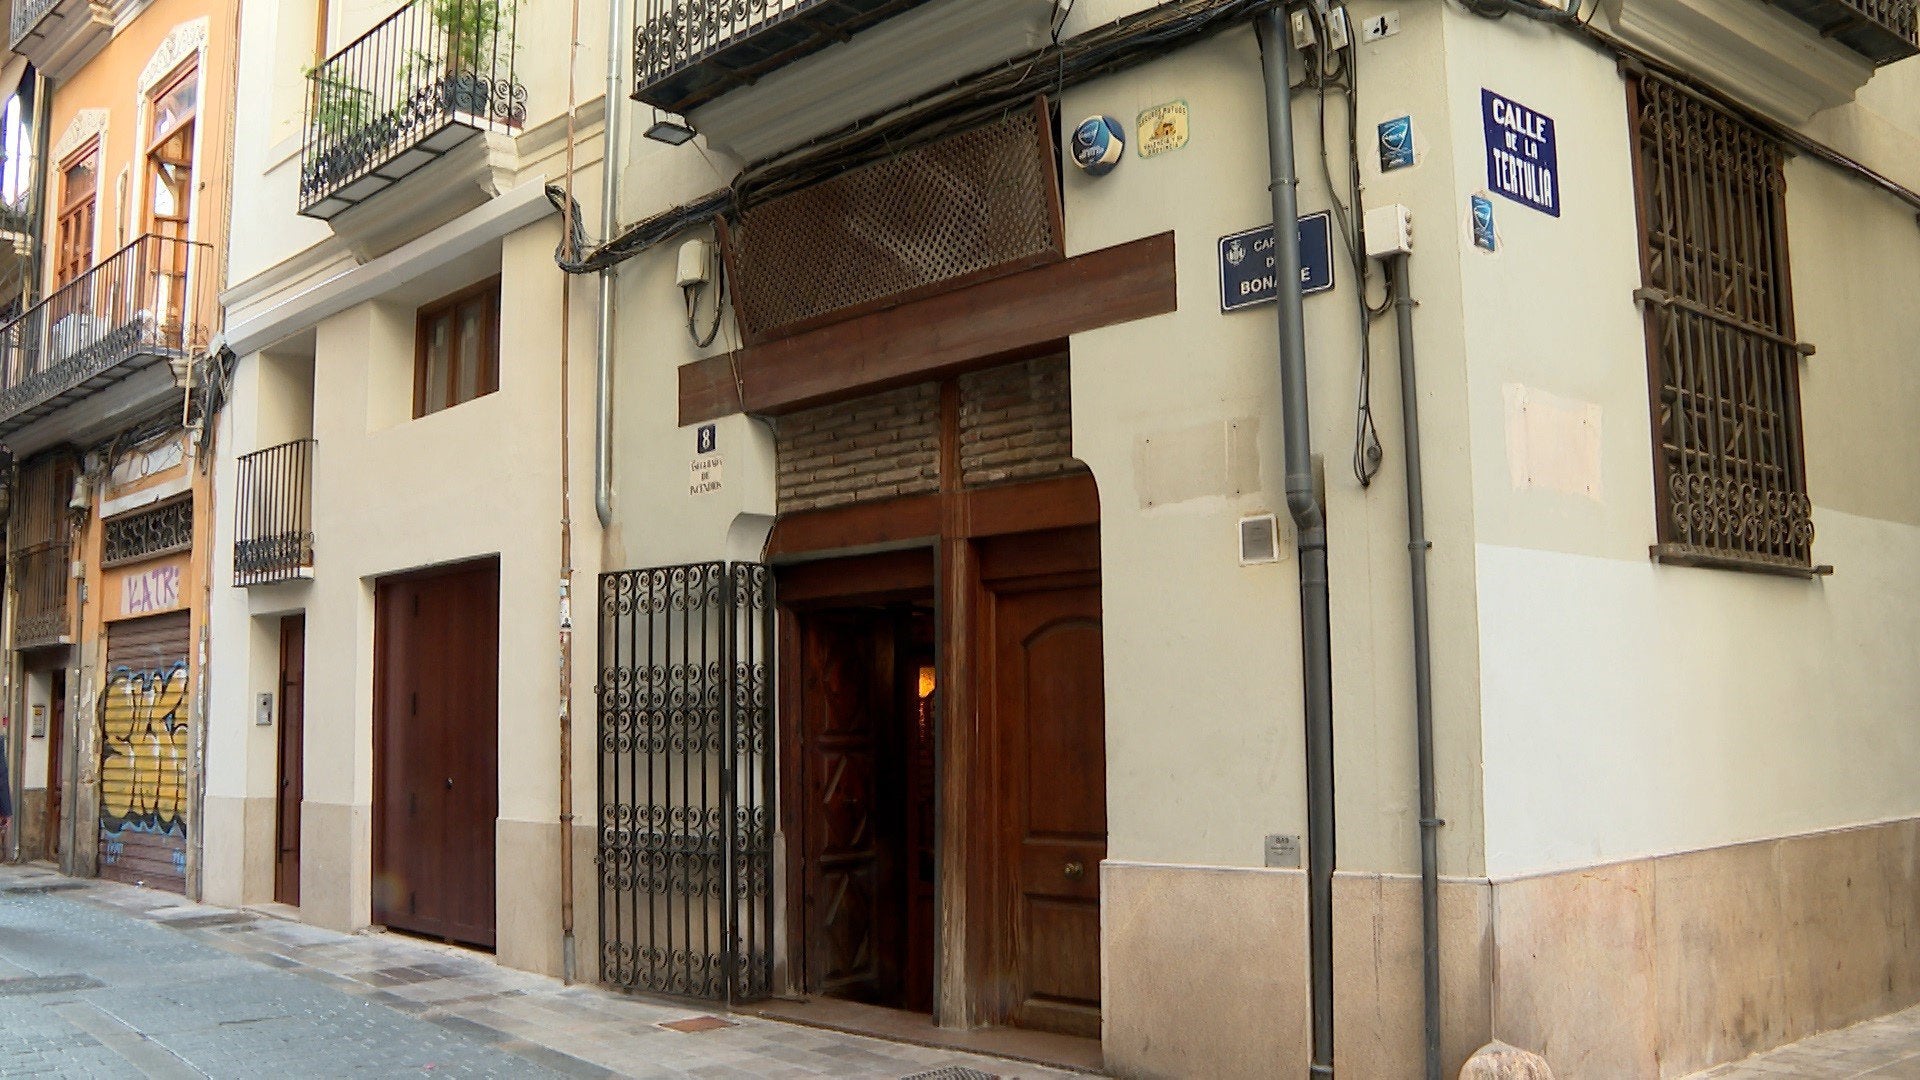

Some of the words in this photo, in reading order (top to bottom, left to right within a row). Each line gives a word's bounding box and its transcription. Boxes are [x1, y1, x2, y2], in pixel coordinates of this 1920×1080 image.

[1492, 97, 1547, 144] CALLE
[1505, 130, 1518, 152] DE
[1524, 137, 1538, 160] LA
[1492, 146, 1553, 209] TERTULIA
[1240, 266, 1312, 295] BONE
[702, 428, 711, 449] 8
